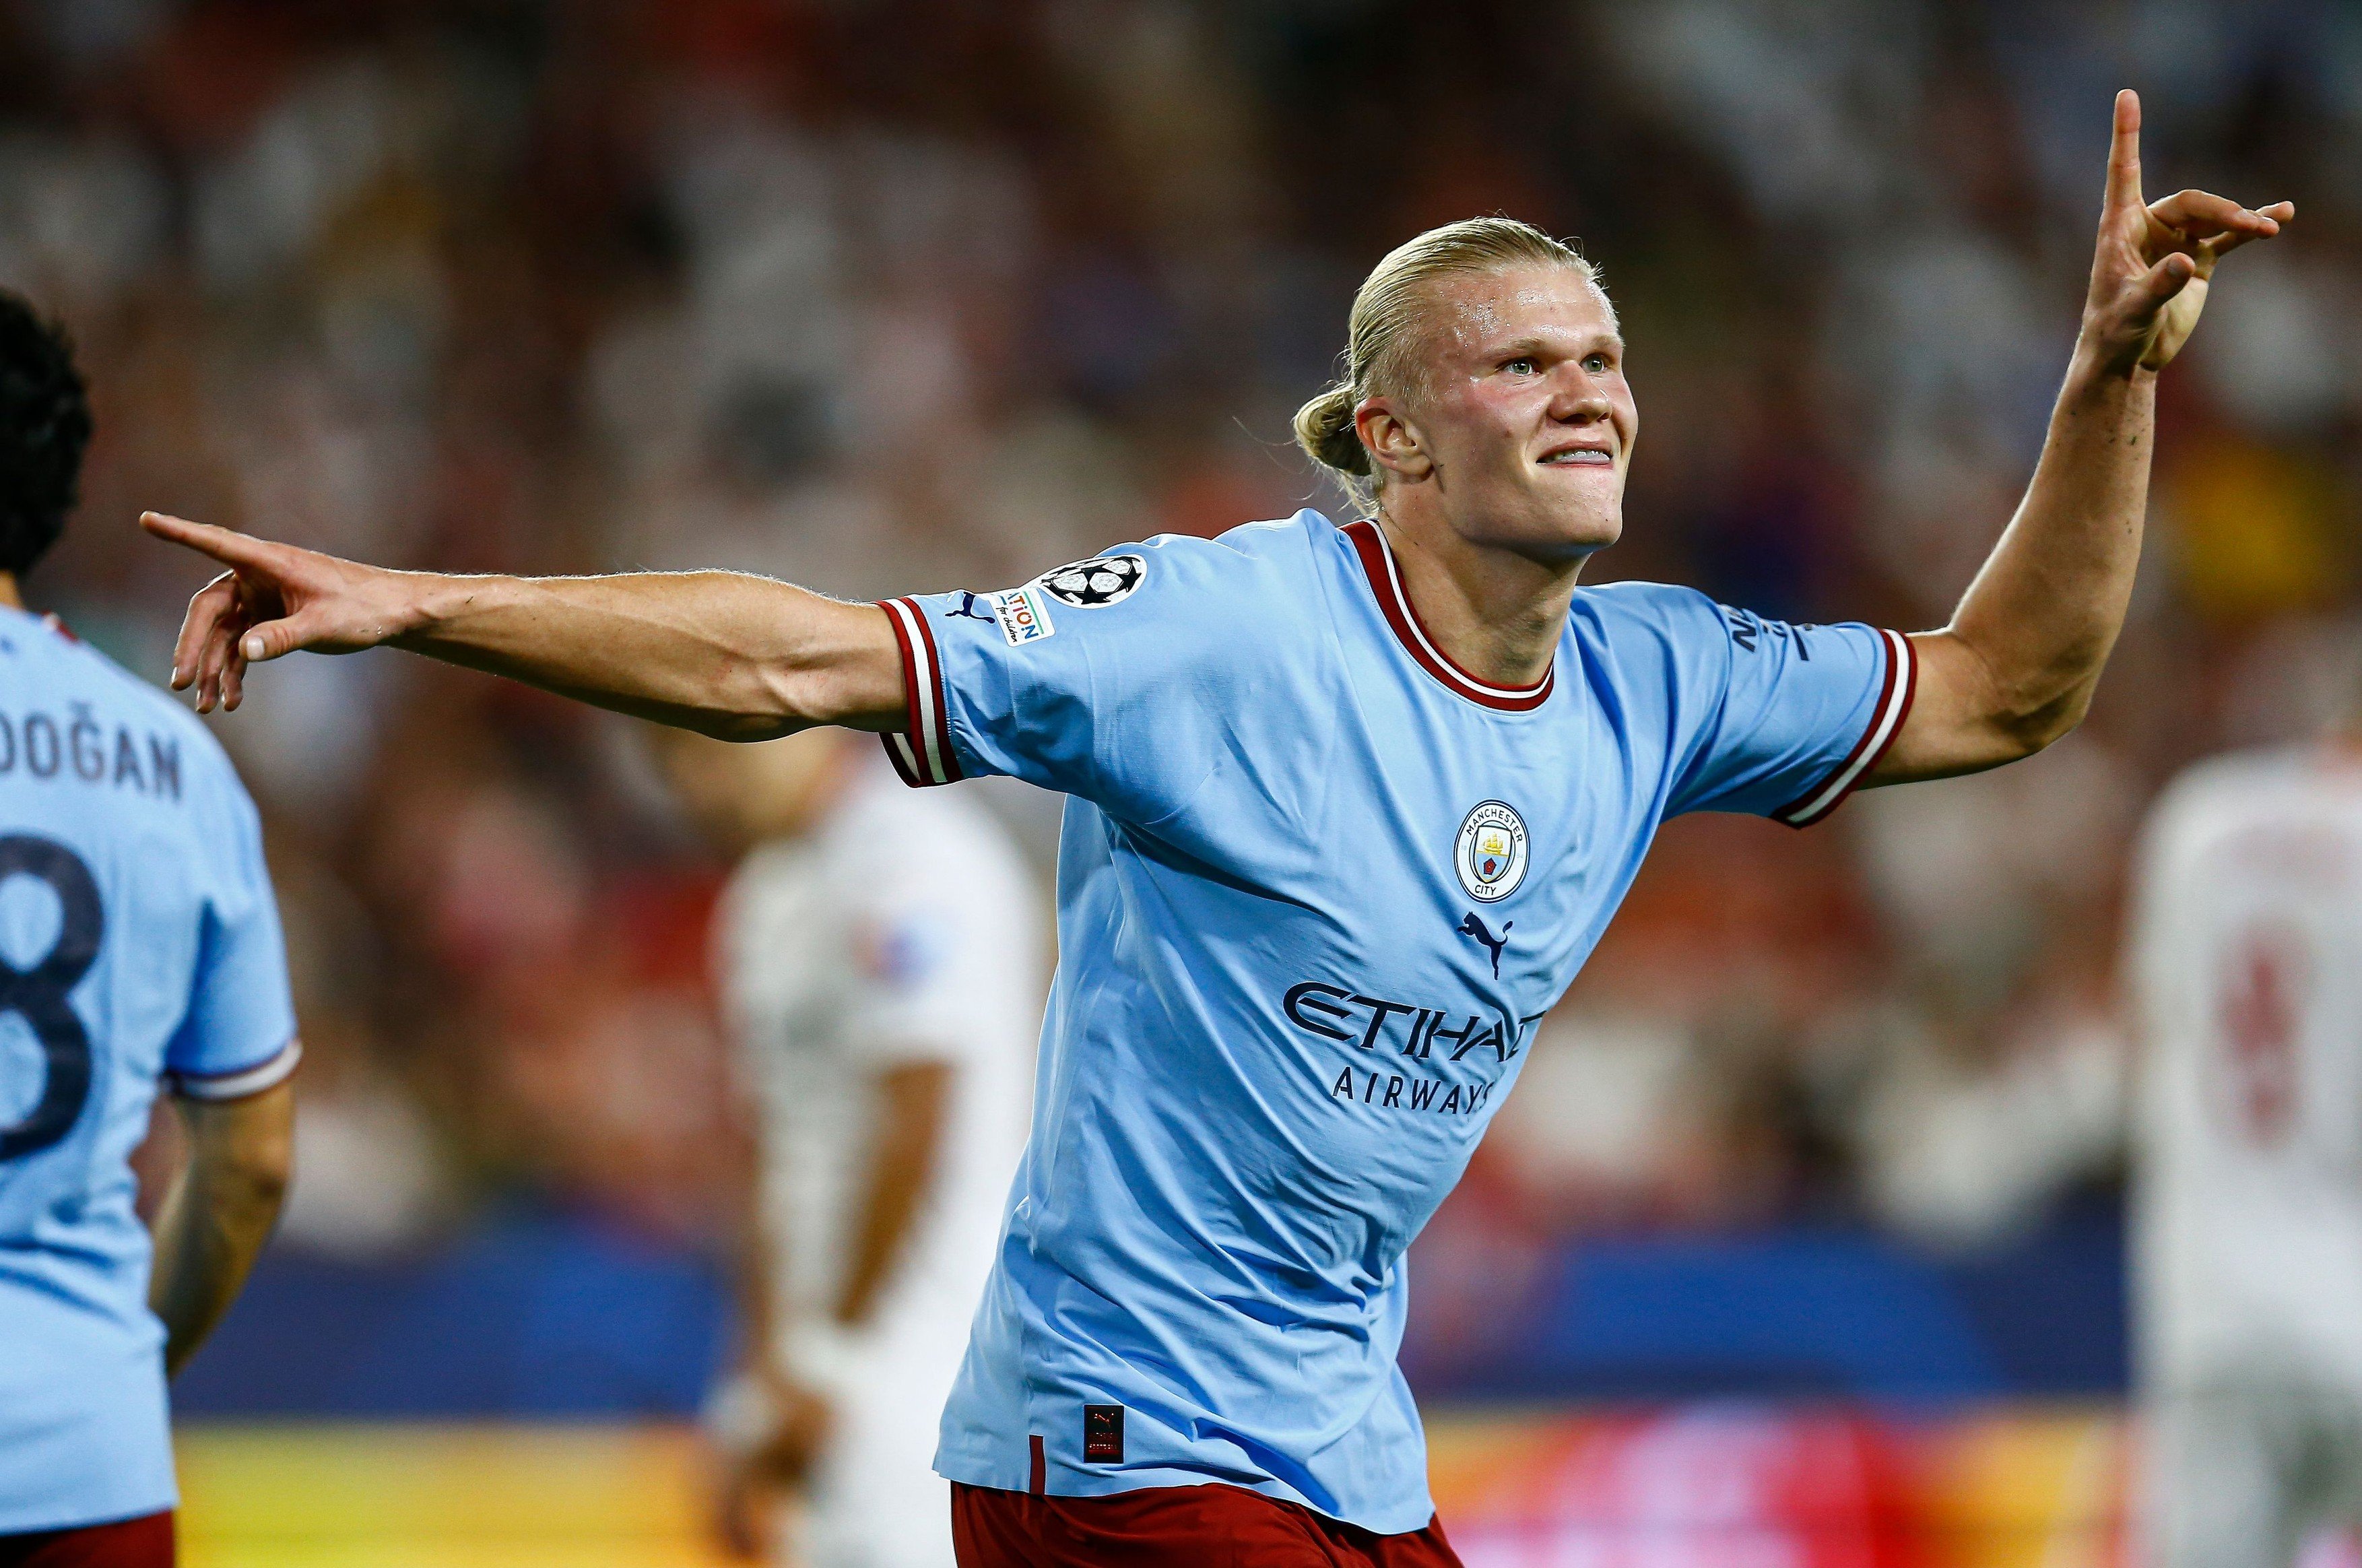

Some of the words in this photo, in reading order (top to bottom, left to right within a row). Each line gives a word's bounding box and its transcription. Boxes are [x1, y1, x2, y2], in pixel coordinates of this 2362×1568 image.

[1003, 617, 1018, 643] children
[1466, 808, 1523, 843] MANCHESTER
[1475, 884, 1497, 896] CITY
